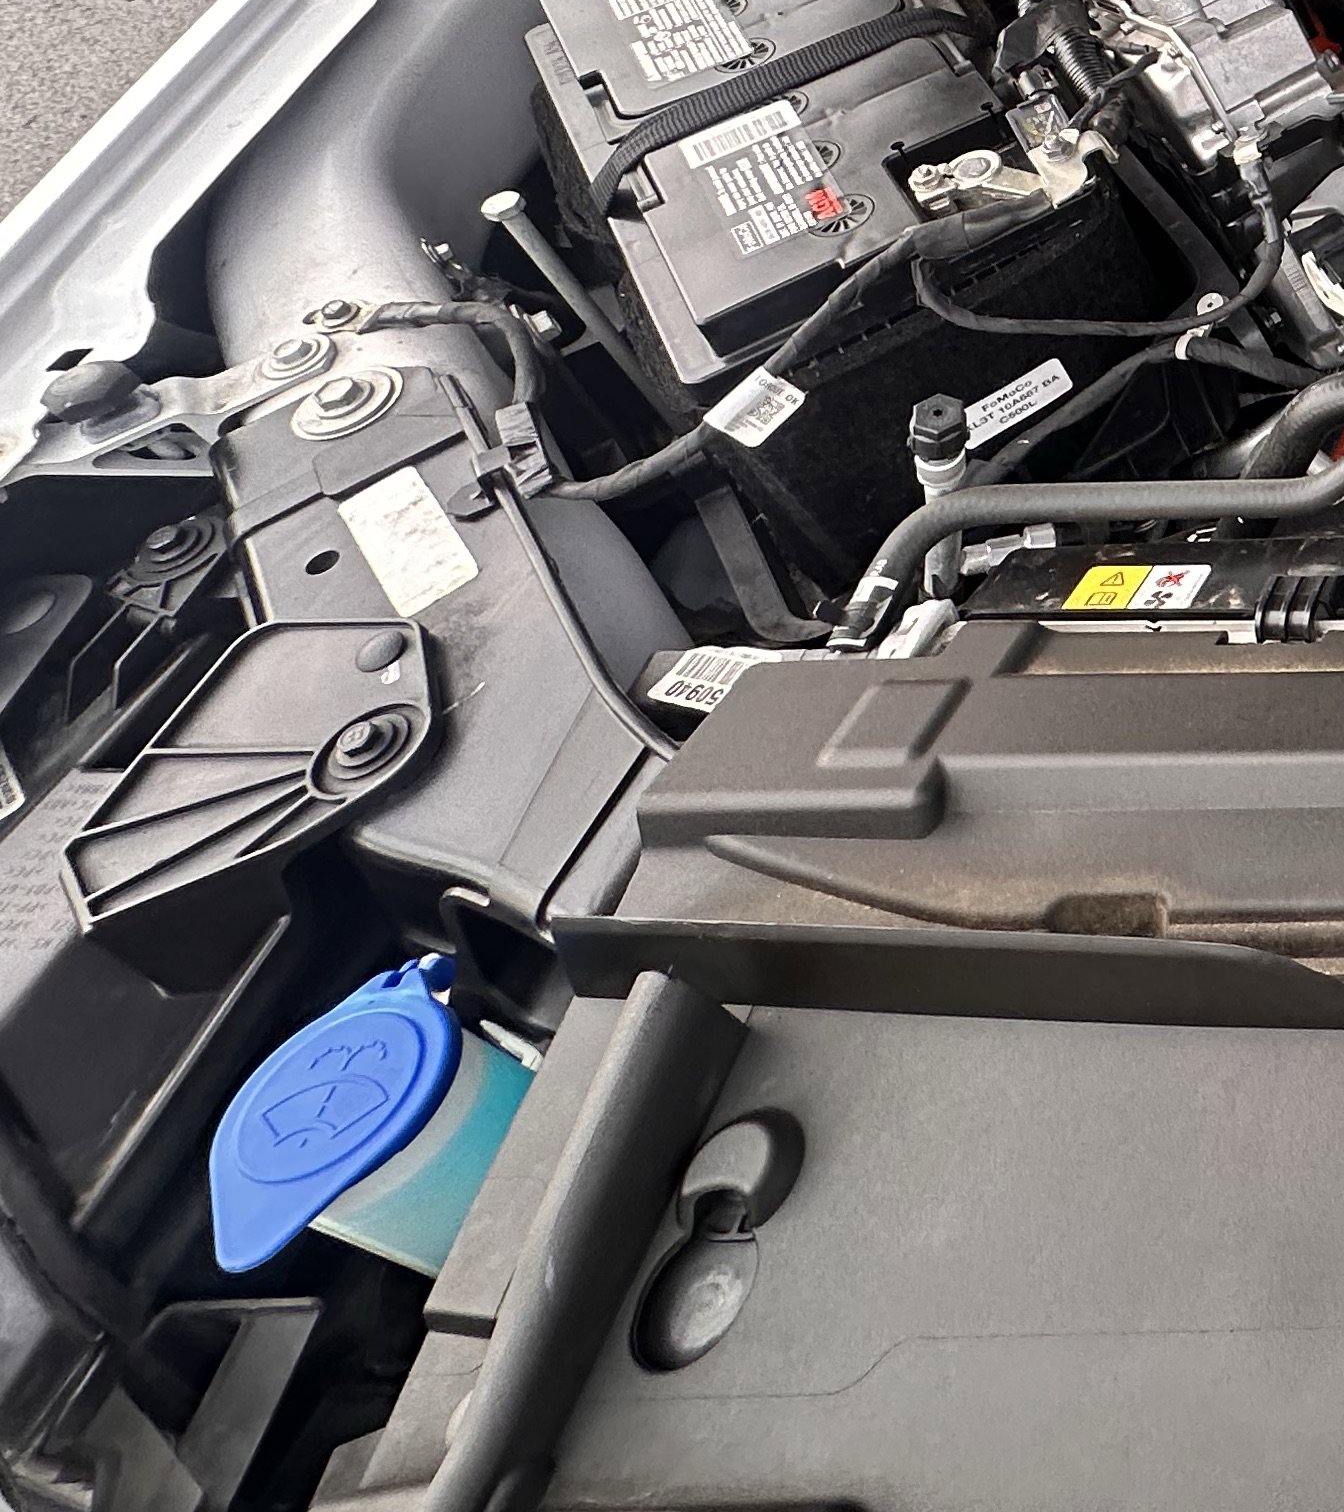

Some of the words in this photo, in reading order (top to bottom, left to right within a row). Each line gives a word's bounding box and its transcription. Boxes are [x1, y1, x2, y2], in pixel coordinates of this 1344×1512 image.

[806, 189, 837, 220] AGM
[785, 394, 800, 406] OK
[981, 380, 1032, 412] FoMoCo
[664, 680, 724, 706] 50940
